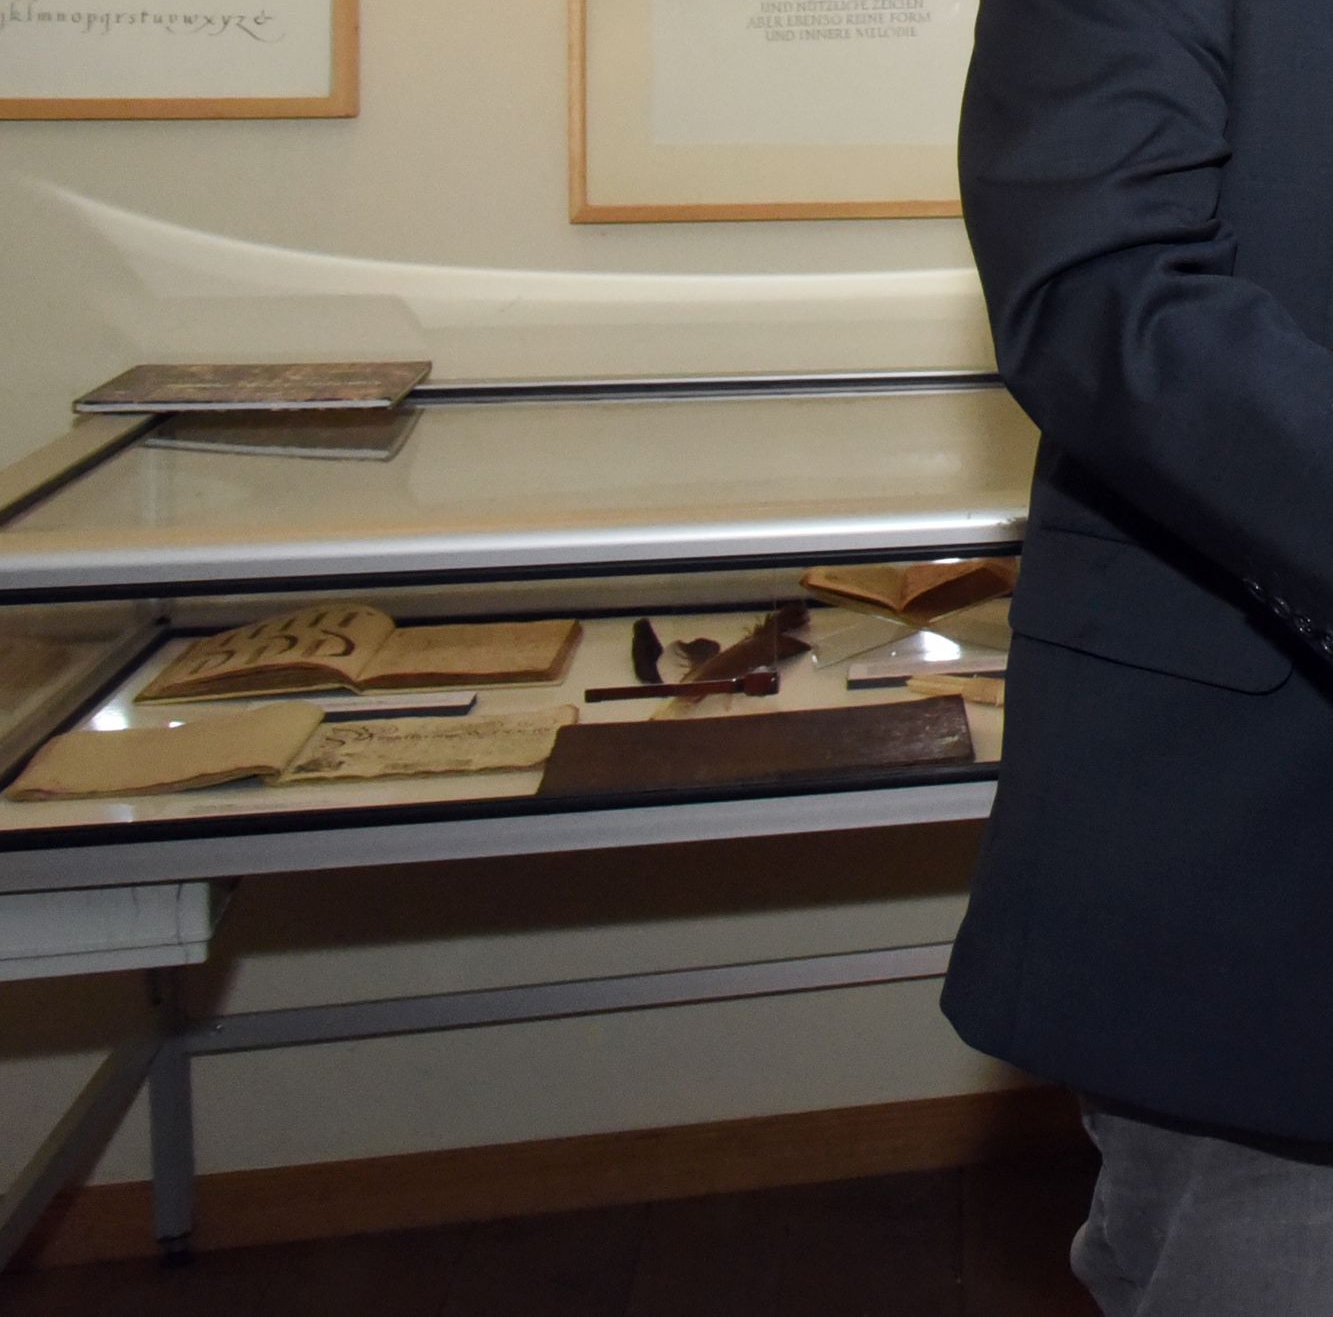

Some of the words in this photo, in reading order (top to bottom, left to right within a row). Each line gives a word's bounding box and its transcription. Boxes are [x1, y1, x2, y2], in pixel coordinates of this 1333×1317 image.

[760, 0, 793, 13] UND
[746, 15, 784, 29] ABER
[846, 13, 886, 26] REINE
[889, 11, 931, 24] FORM
[765, 29, 796, 42] UND
